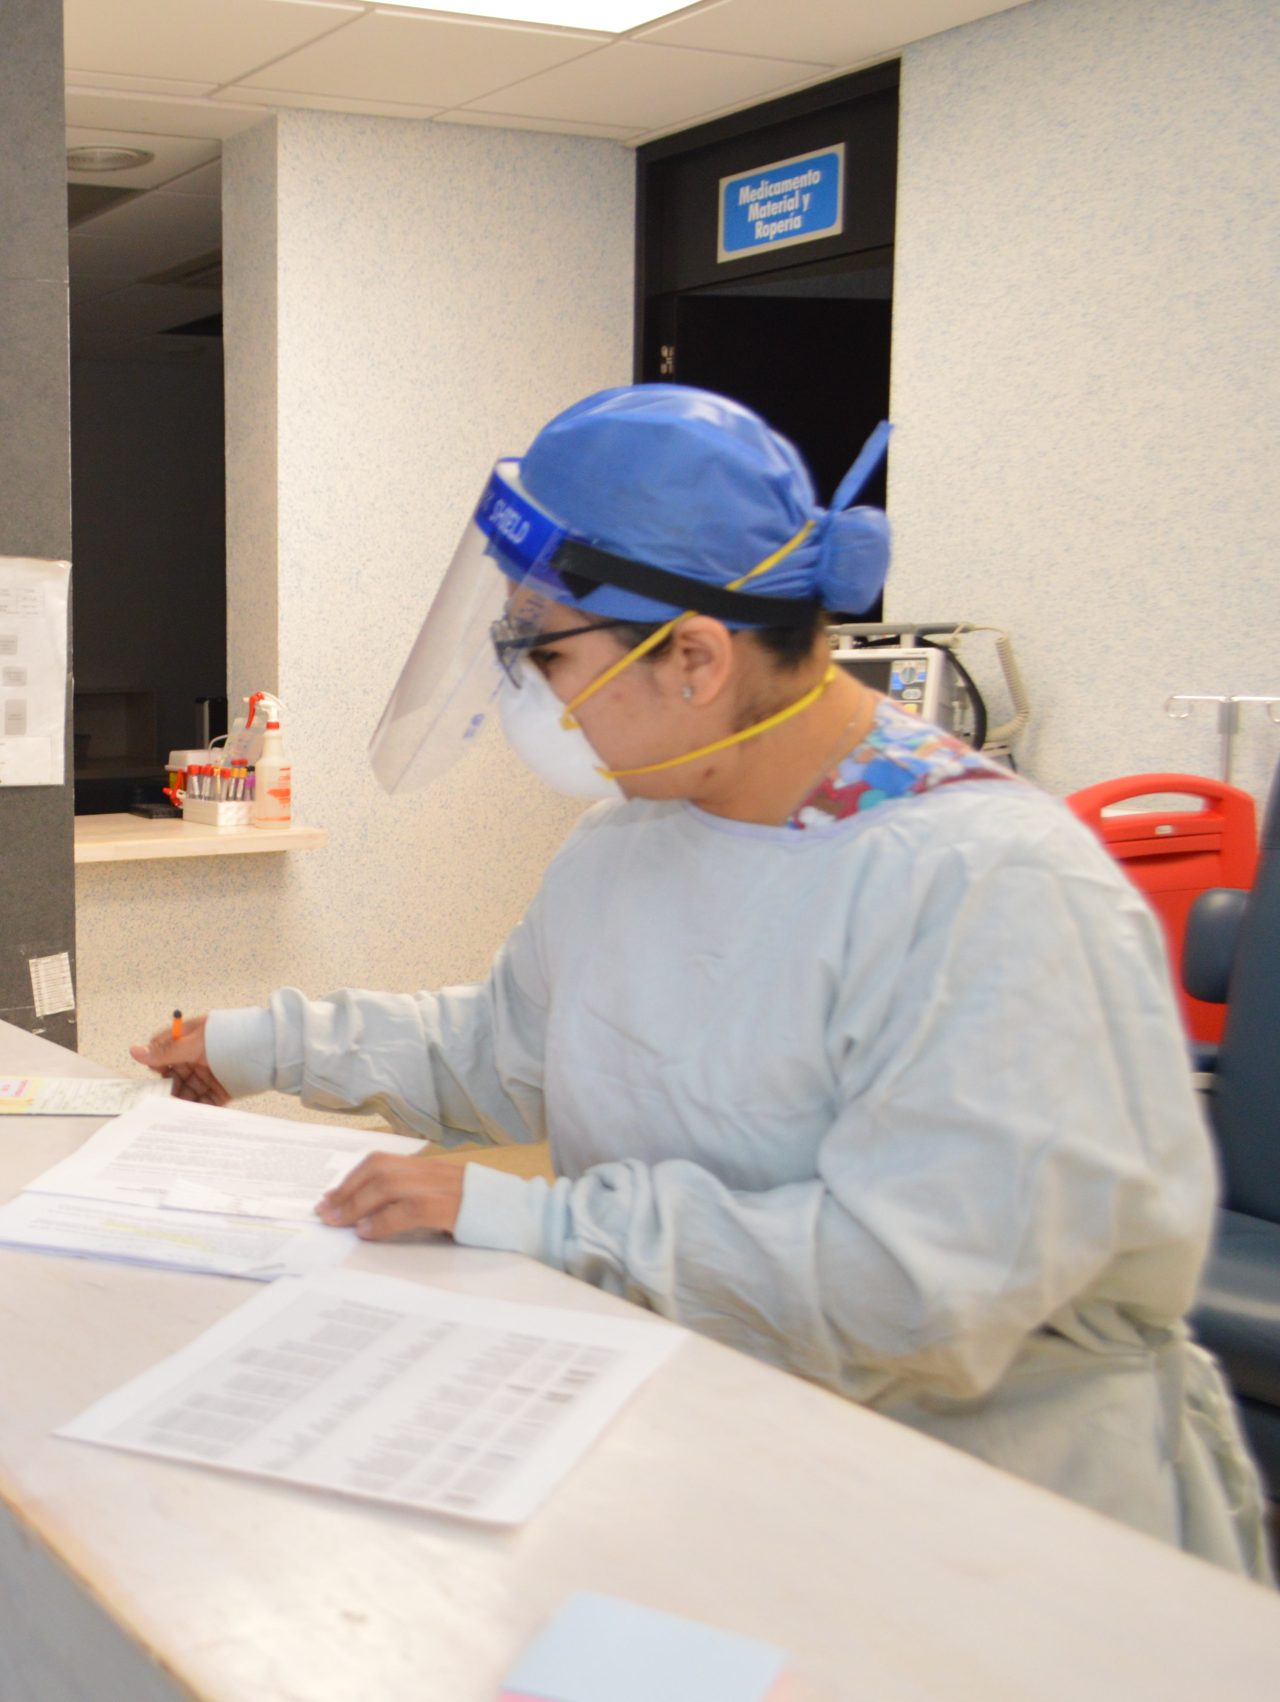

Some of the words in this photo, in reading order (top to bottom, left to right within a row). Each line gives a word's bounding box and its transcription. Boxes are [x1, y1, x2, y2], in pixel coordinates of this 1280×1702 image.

[738, 169, 822, 205] Medicamento
[747, 191, 800, 222] Material
[802, 193, 811, 212] y
[755, 212, 802, 240] Ropería
[488, 498, 531, 545] SHIELD
